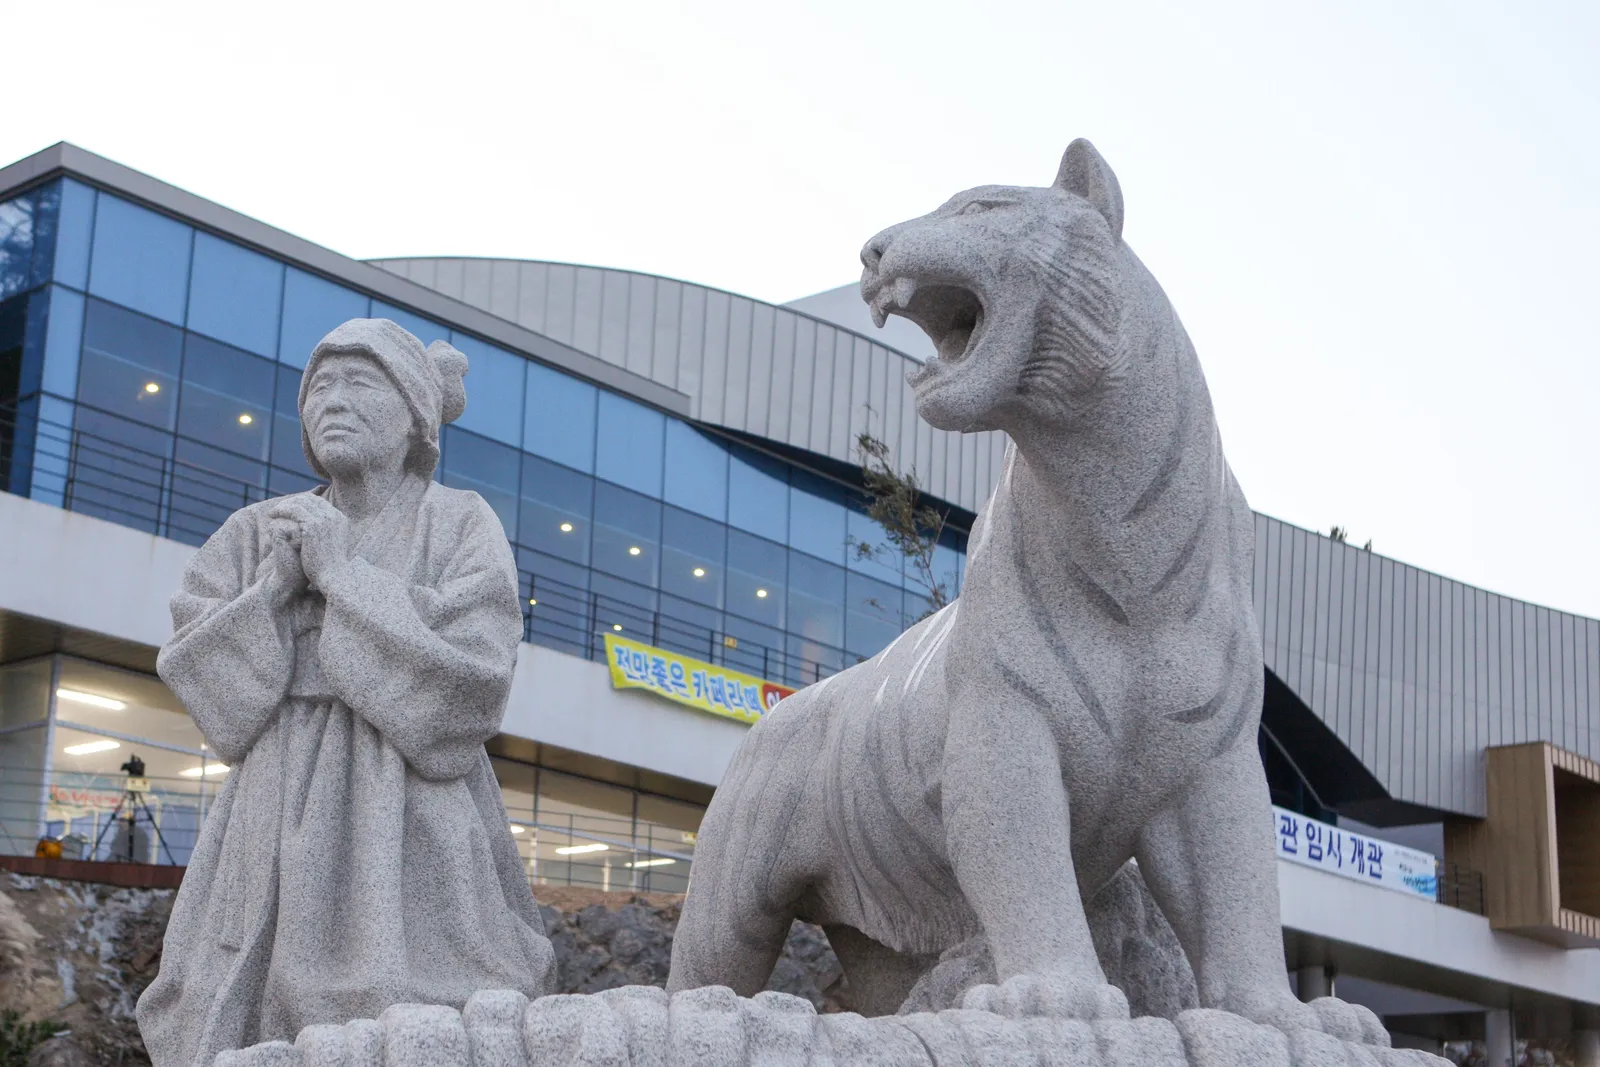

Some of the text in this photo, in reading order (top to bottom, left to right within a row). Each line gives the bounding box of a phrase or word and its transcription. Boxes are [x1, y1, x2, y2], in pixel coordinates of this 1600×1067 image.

[1273, 812, 1383, 879] 관 임시 개관
